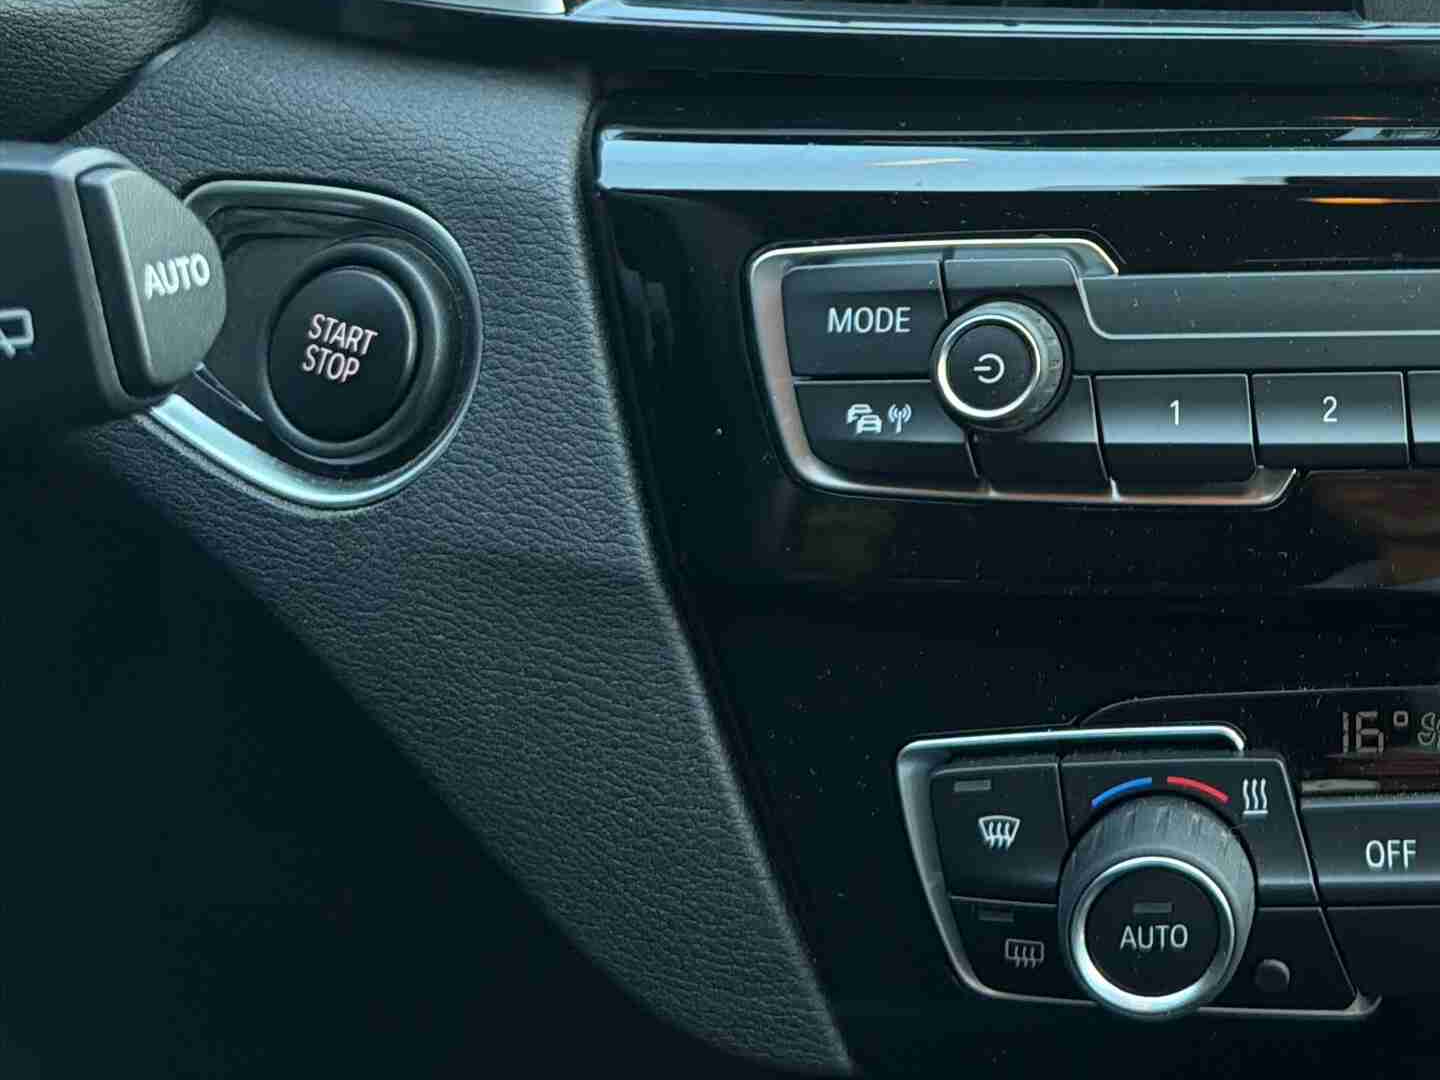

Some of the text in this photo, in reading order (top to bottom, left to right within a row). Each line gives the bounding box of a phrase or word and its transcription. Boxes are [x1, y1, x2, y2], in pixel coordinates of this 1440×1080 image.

[142, 252, 211, 300] AUTO
[307, 312, 378, 356] START
[826, 306, 912, 334] MODE
[301, 343, 361, 384] STOP
[1168, 399, 1181, 426] 1
[1322, 396, 1338, 423] 2
[1365, 839, 1418, 870] OFF
[1119, 923, 1190, 951] AUTO
